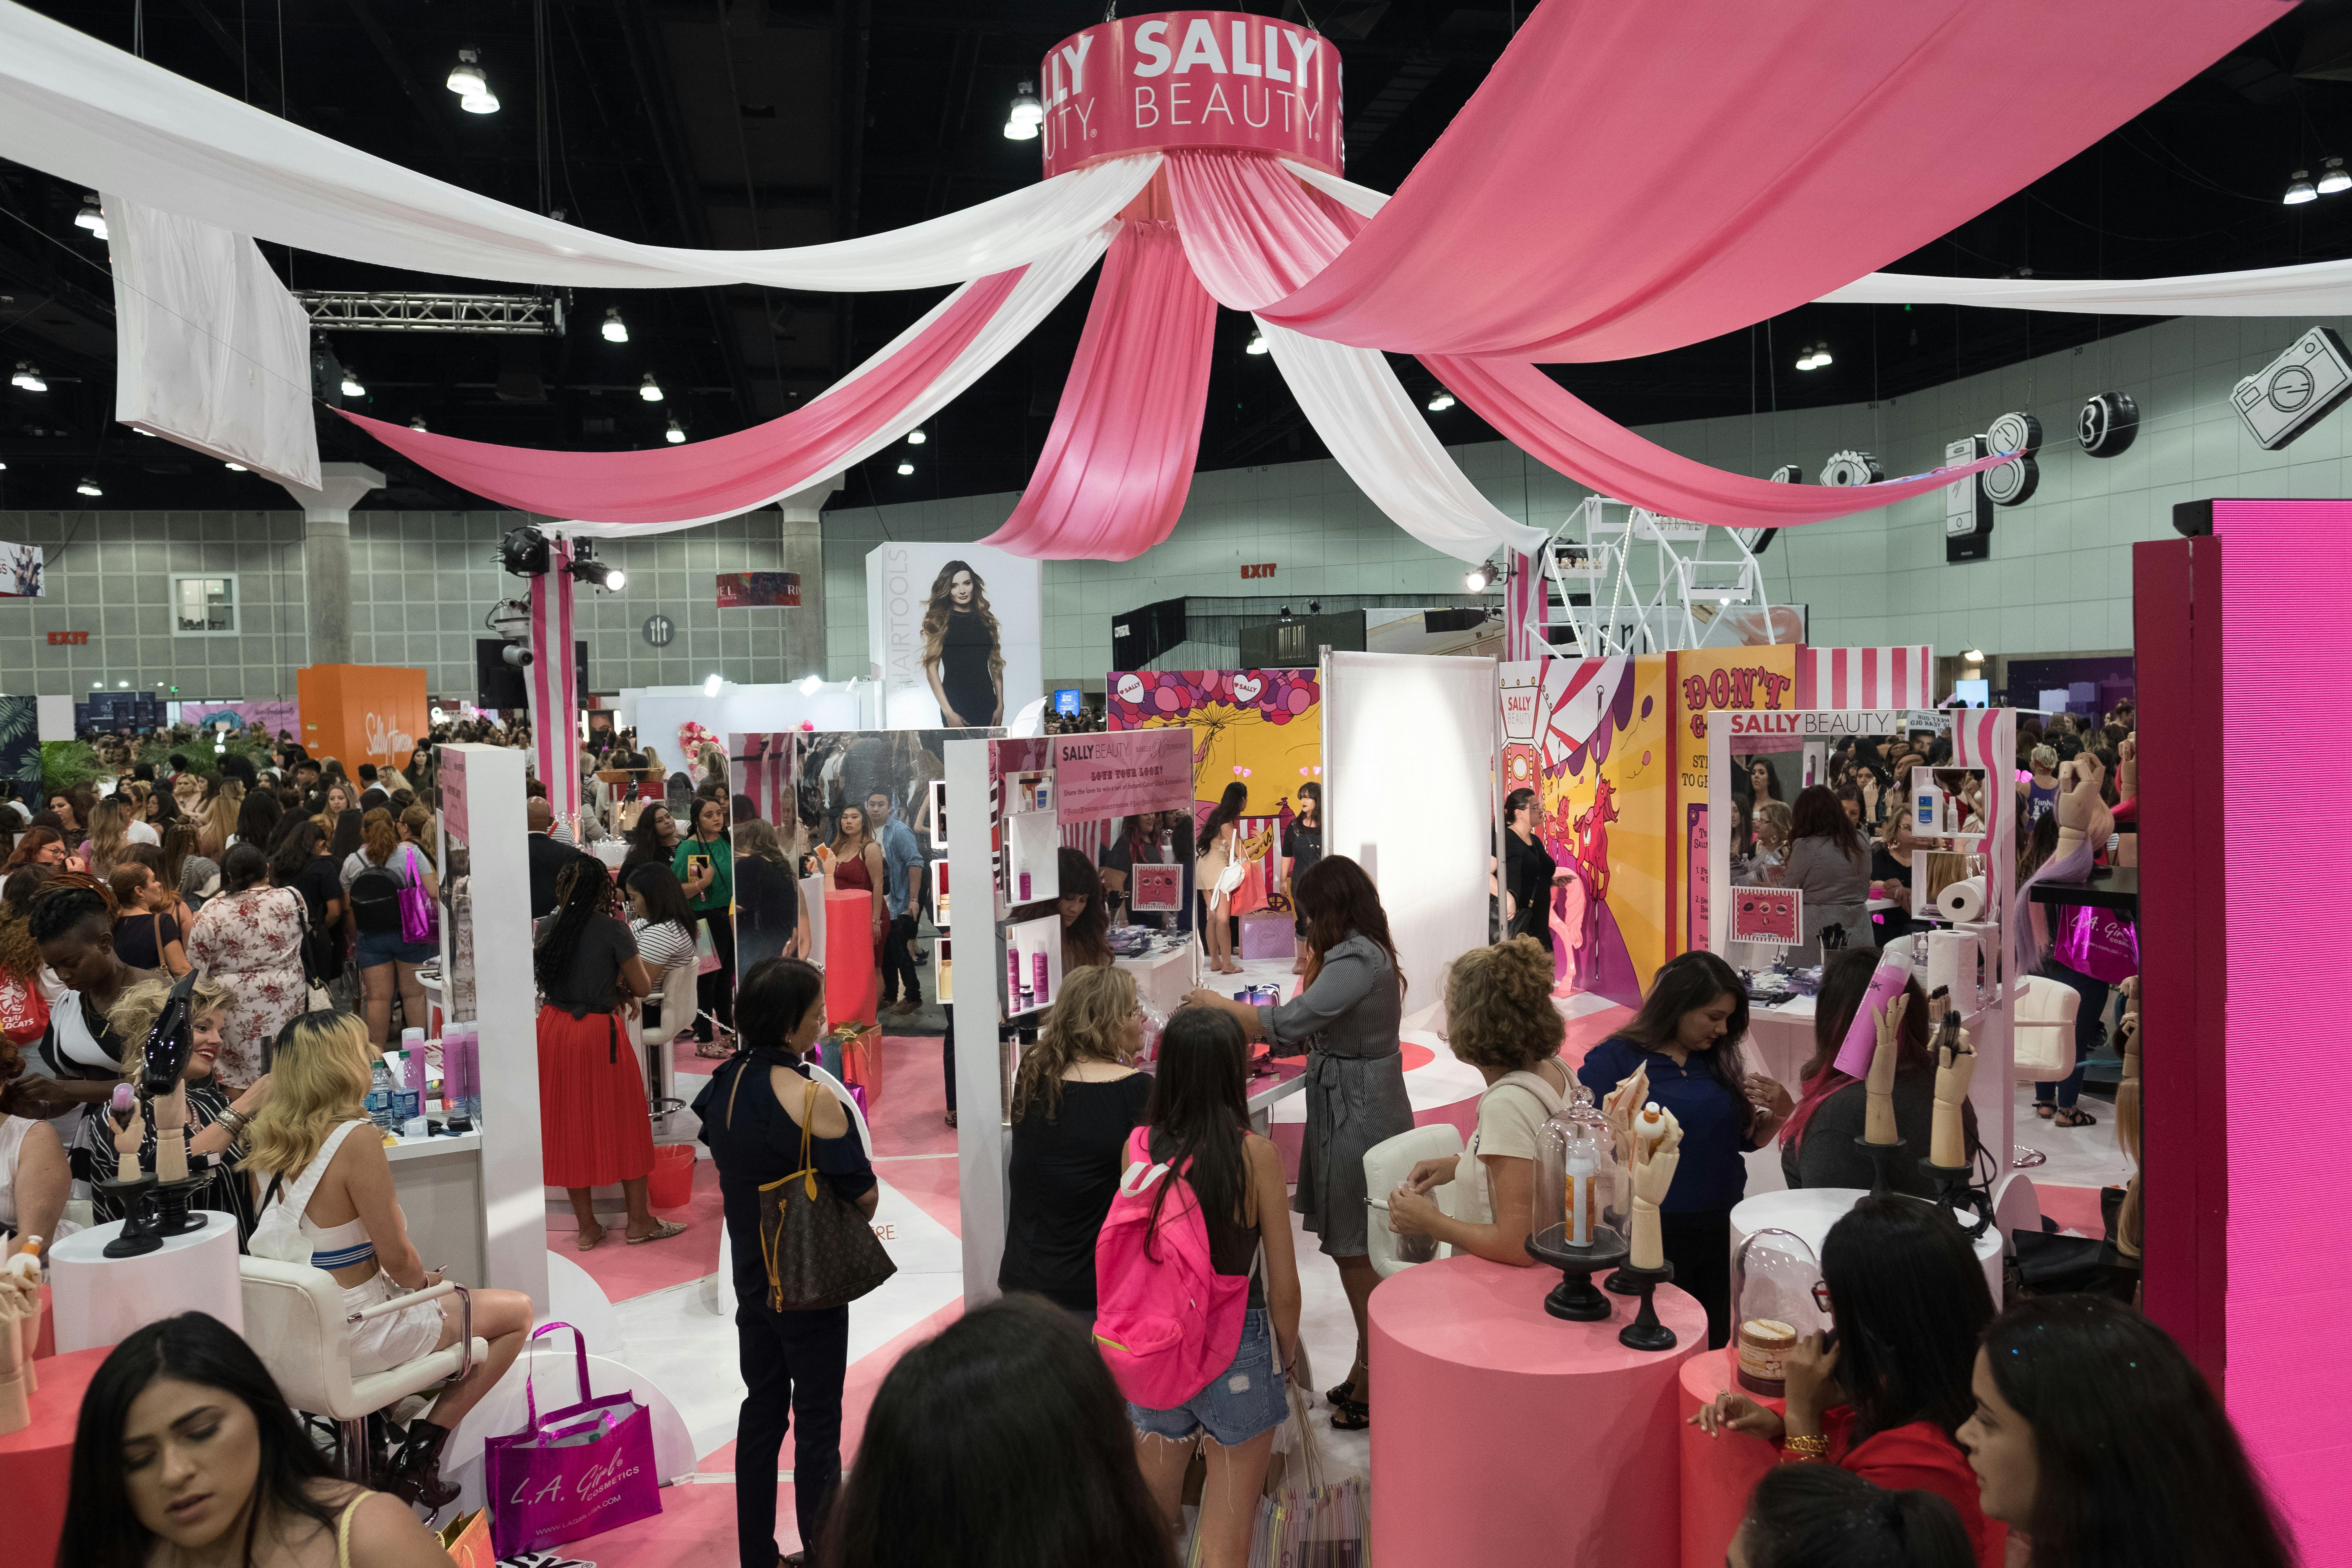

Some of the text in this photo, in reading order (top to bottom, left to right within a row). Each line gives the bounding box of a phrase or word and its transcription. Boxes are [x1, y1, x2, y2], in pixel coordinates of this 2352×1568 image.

[1133, 19, 1317, 88] SALLY
[1136, 83, 1318, 139] BEAUTY
[1241, 563, 1277, 579] EXIT
[47, 631, 89, 644] EXIT
[1124, 682, 1141, 693] SALLY
[1238, 683, 1257, 693] SALLY
[1682, 666, 1791, 711] DON'T
[1508, 696, 1532, 711] SALLY
[1508, 713, 1531, 724] BEAUTY
[1690, 714, 1708, 739] G
[1730, 713, 1889, 733] SALLY BEAUTY
[366, 712, 388, 765] Sally
[1063, 742, 1129, 761] SALLY BEAUTY
[1091, 765, 1163, 781] LOVE YOUR LOOK!
[1682, 773, 1695, 787] TO
[2, 1014, 21, 1023] CWU
[871, 1225, 896, 1241] RE
[510, 1447, 622, 1505] L.A. Girl
[587, 1466, 640, 1501] COSMETICS
[535, 1494, 621, 1536] WWW.LAGIRLUSA.COM
